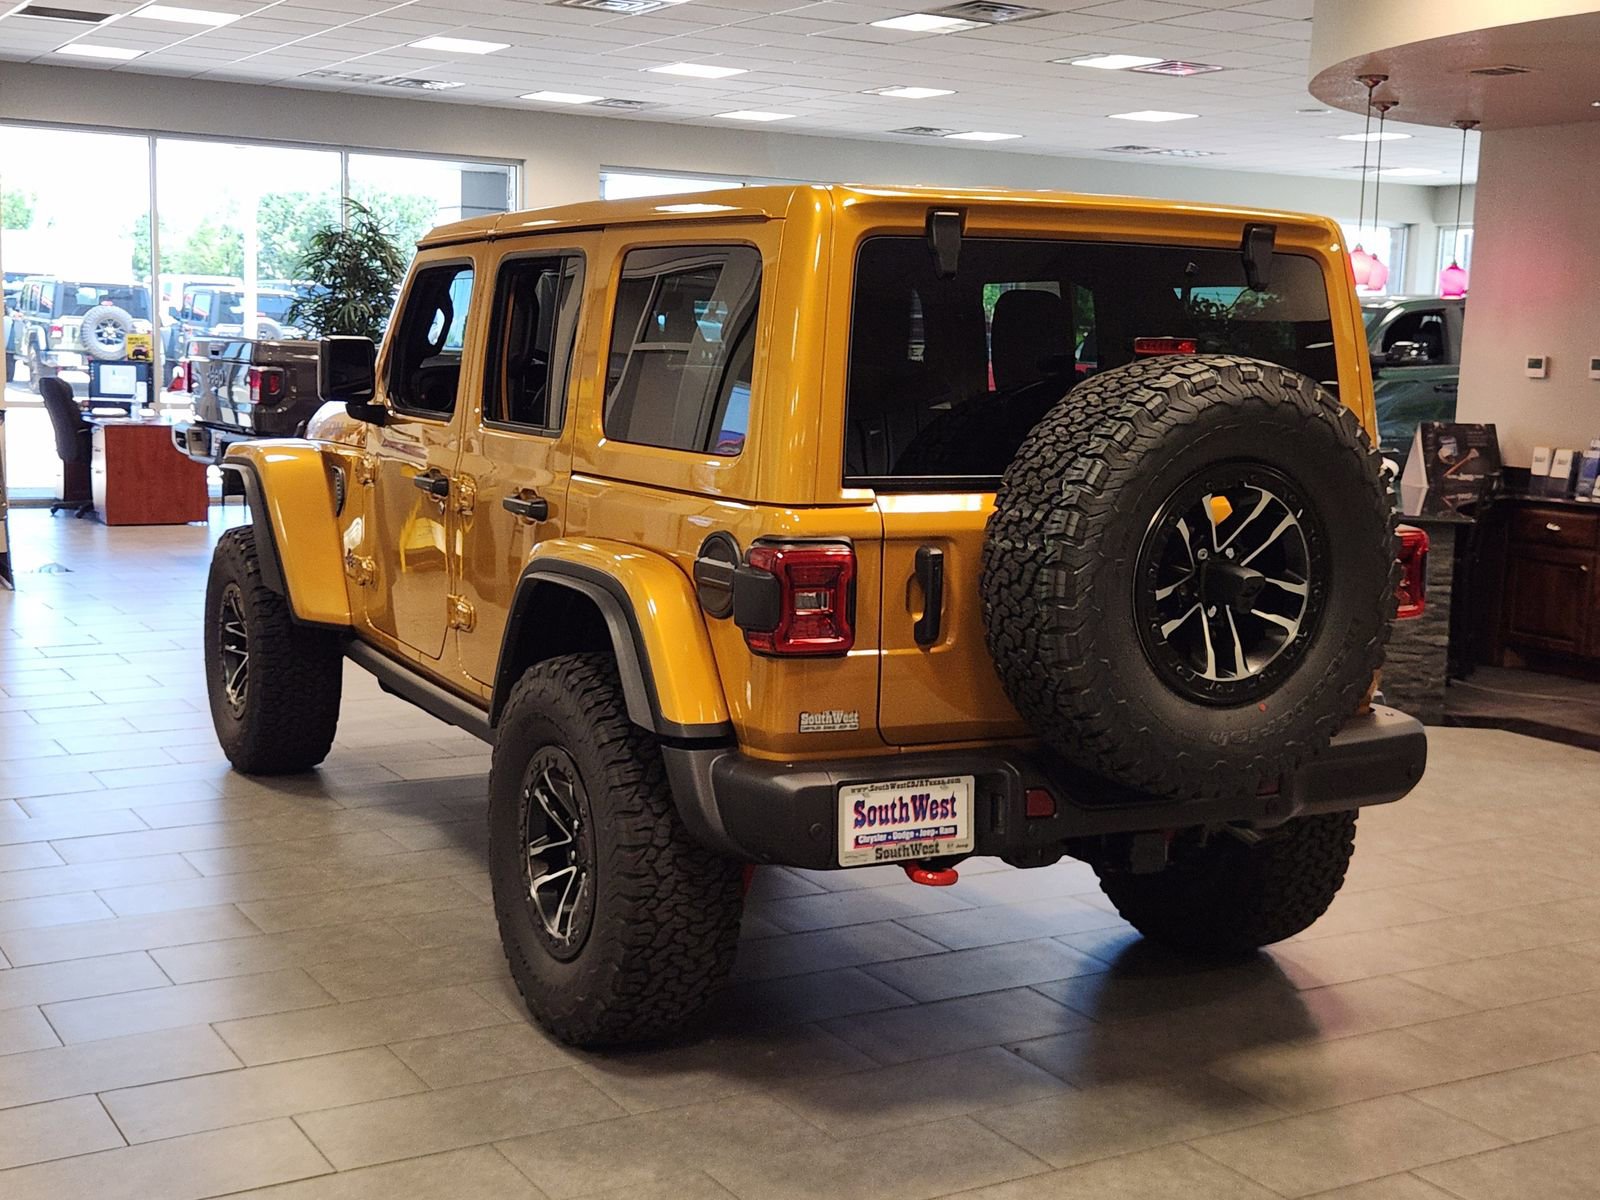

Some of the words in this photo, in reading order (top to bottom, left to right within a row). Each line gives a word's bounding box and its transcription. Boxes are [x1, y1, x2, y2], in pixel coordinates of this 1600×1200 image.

[800, 710, 859, 725] SouthWest
[853, 791, 957, 829] SouthWest
[858, 833, 887, 844] Chrysler
[892, 829, 914, 840] Dodge
[920, 827, 935, 838] Jeep
[939, 825, 955, 834] Ram
[875, 840, 940, 861] SouthWest
